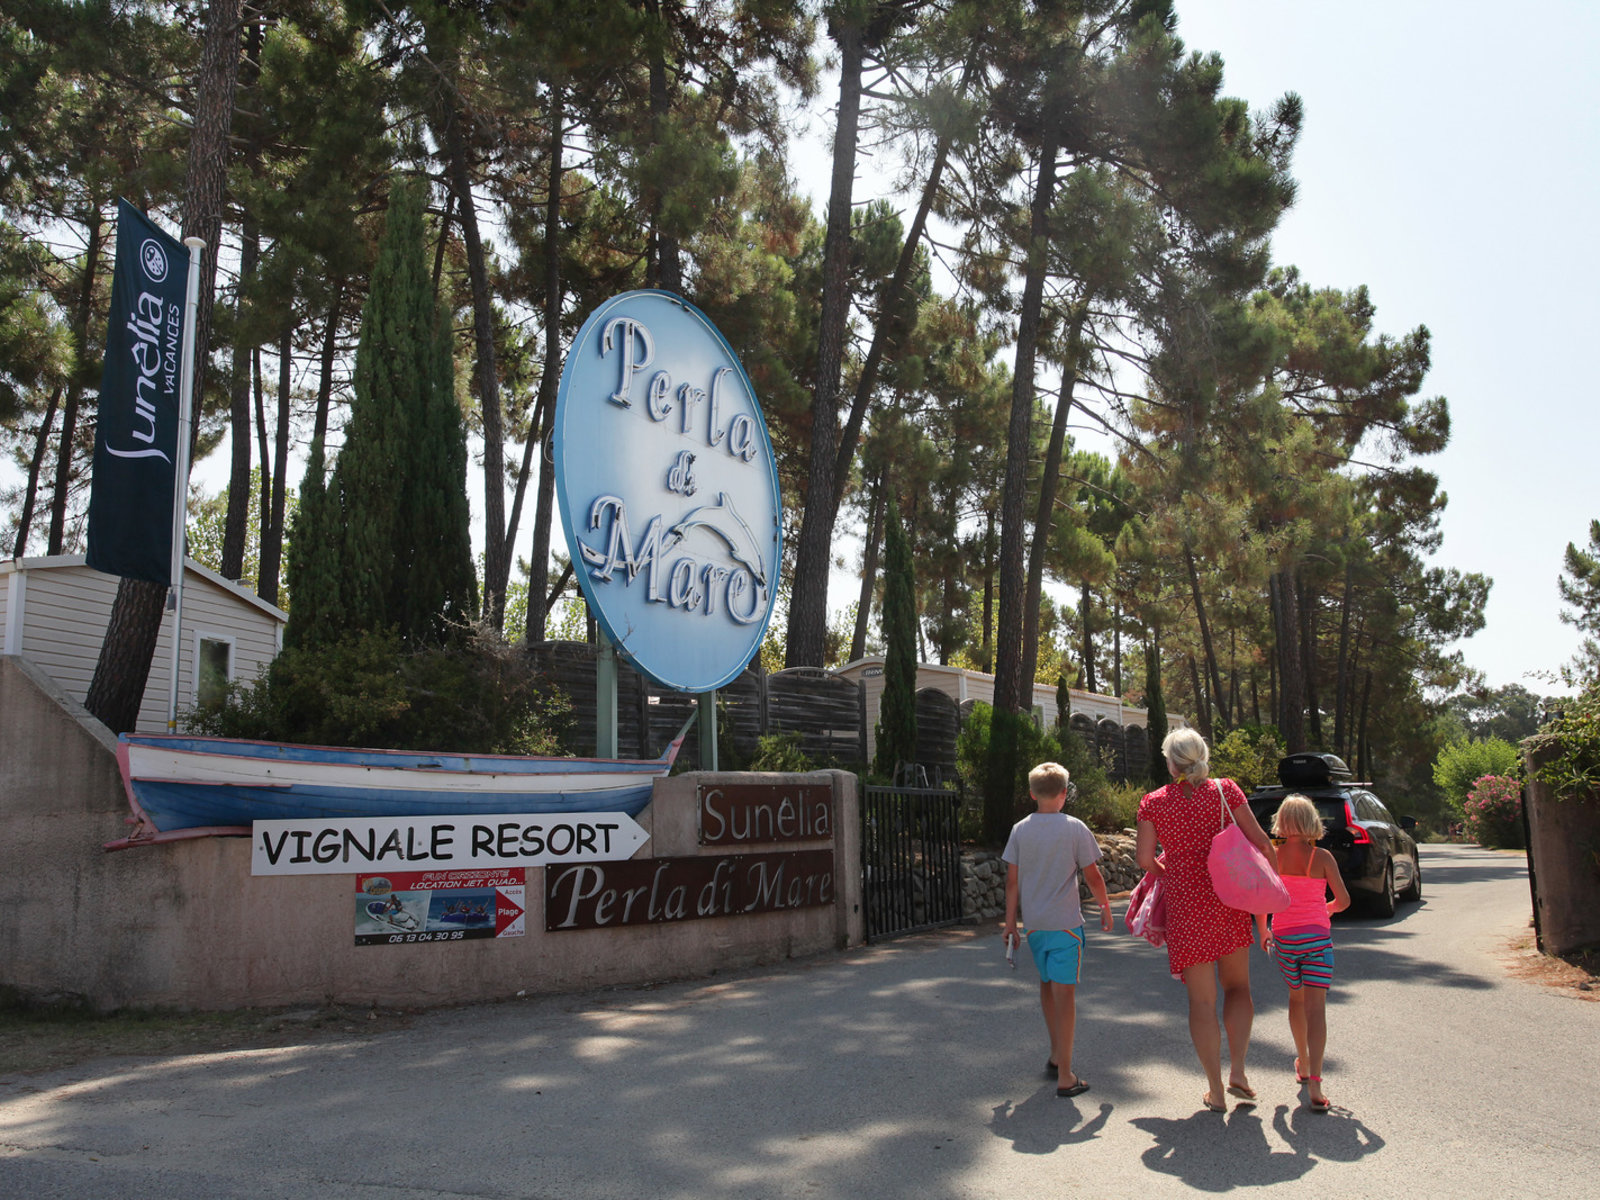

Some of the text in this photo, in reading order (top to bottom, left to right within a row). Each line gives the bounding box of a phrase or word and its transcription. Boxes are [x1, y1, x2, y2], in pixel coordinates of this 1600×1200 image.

[163, 303, 180, 395] VACANCES
[601, 316, 758, 463] Perla
[578, 495, 769, 626] Mare
[262, 823, 620, 866] VIGNALE RESORT
[410, 881, 462, 890] LOCATION
[498, 908, 519, 917] Plage
[550, 859, 832, 928] Perla di Mare
[388, 930, 465, 944] 06 13 04 30 95
